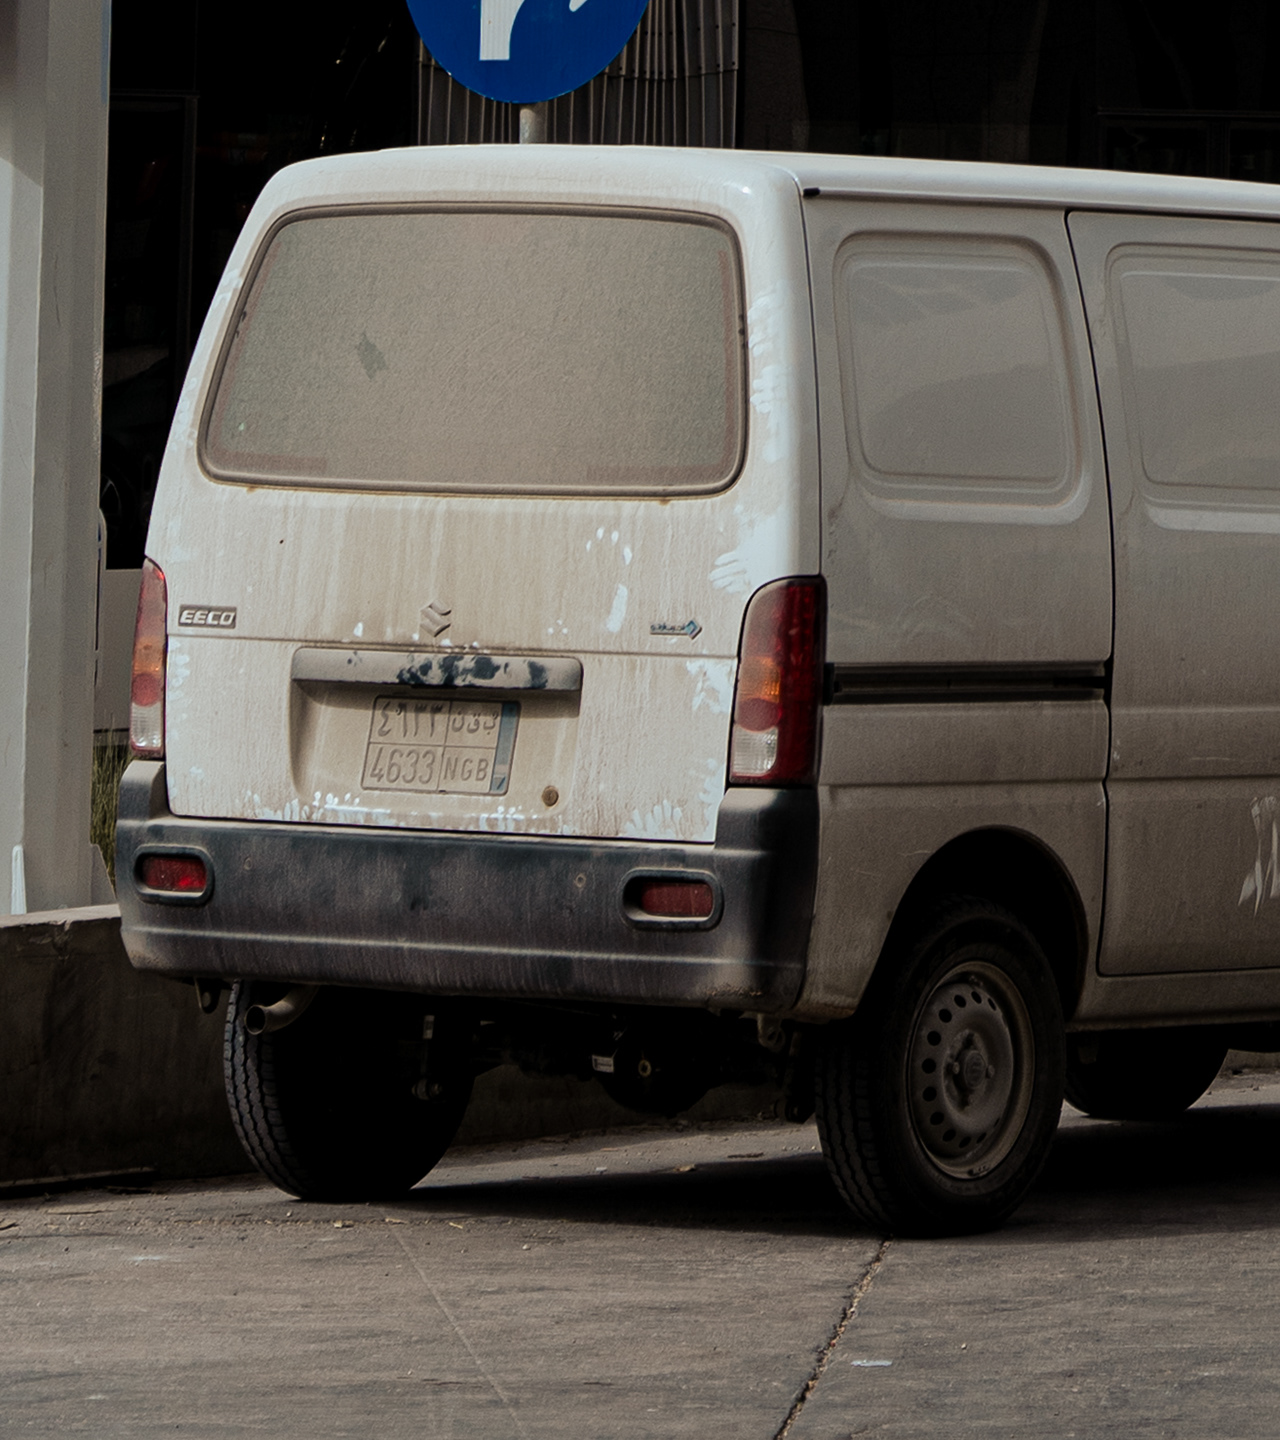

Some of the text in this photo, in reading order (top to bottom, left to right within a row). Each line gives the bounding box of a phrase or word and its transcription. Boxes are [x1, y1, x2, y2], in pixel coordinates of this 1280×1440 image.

[179, 609, 235, 627] EECO
[370, 747, 489, 784] 4633 NGB
